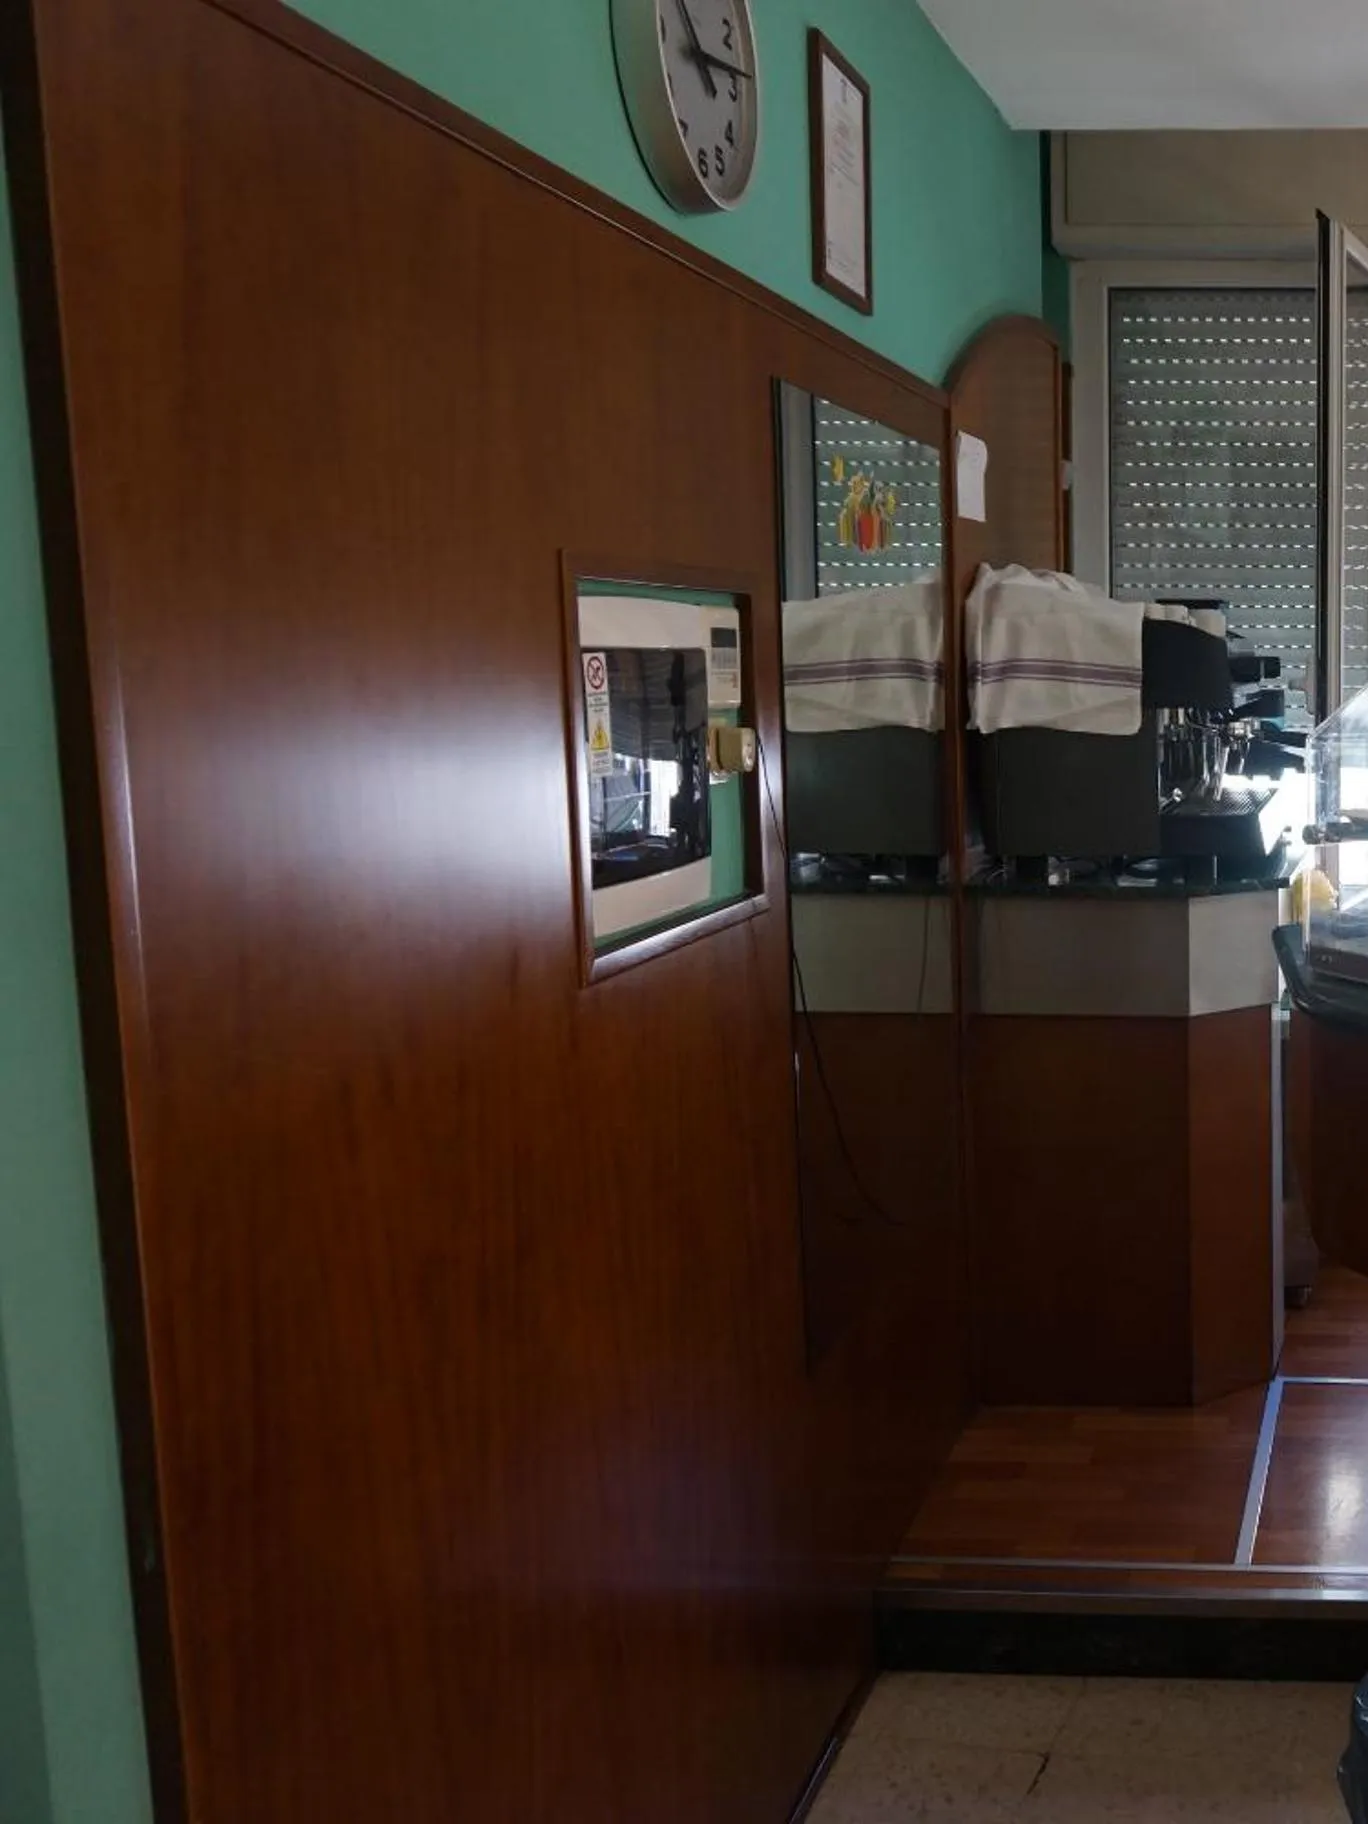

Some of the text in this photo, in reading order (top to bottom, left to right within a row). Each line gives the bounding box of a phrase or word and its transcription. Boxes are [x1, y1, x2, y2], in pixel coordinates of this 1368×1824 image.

[721, 17, 733, 50] 2
[724, 119, 735, 148] 4
[697, 147, 709, 179] 6
[714, 144, 725, 177] 5
